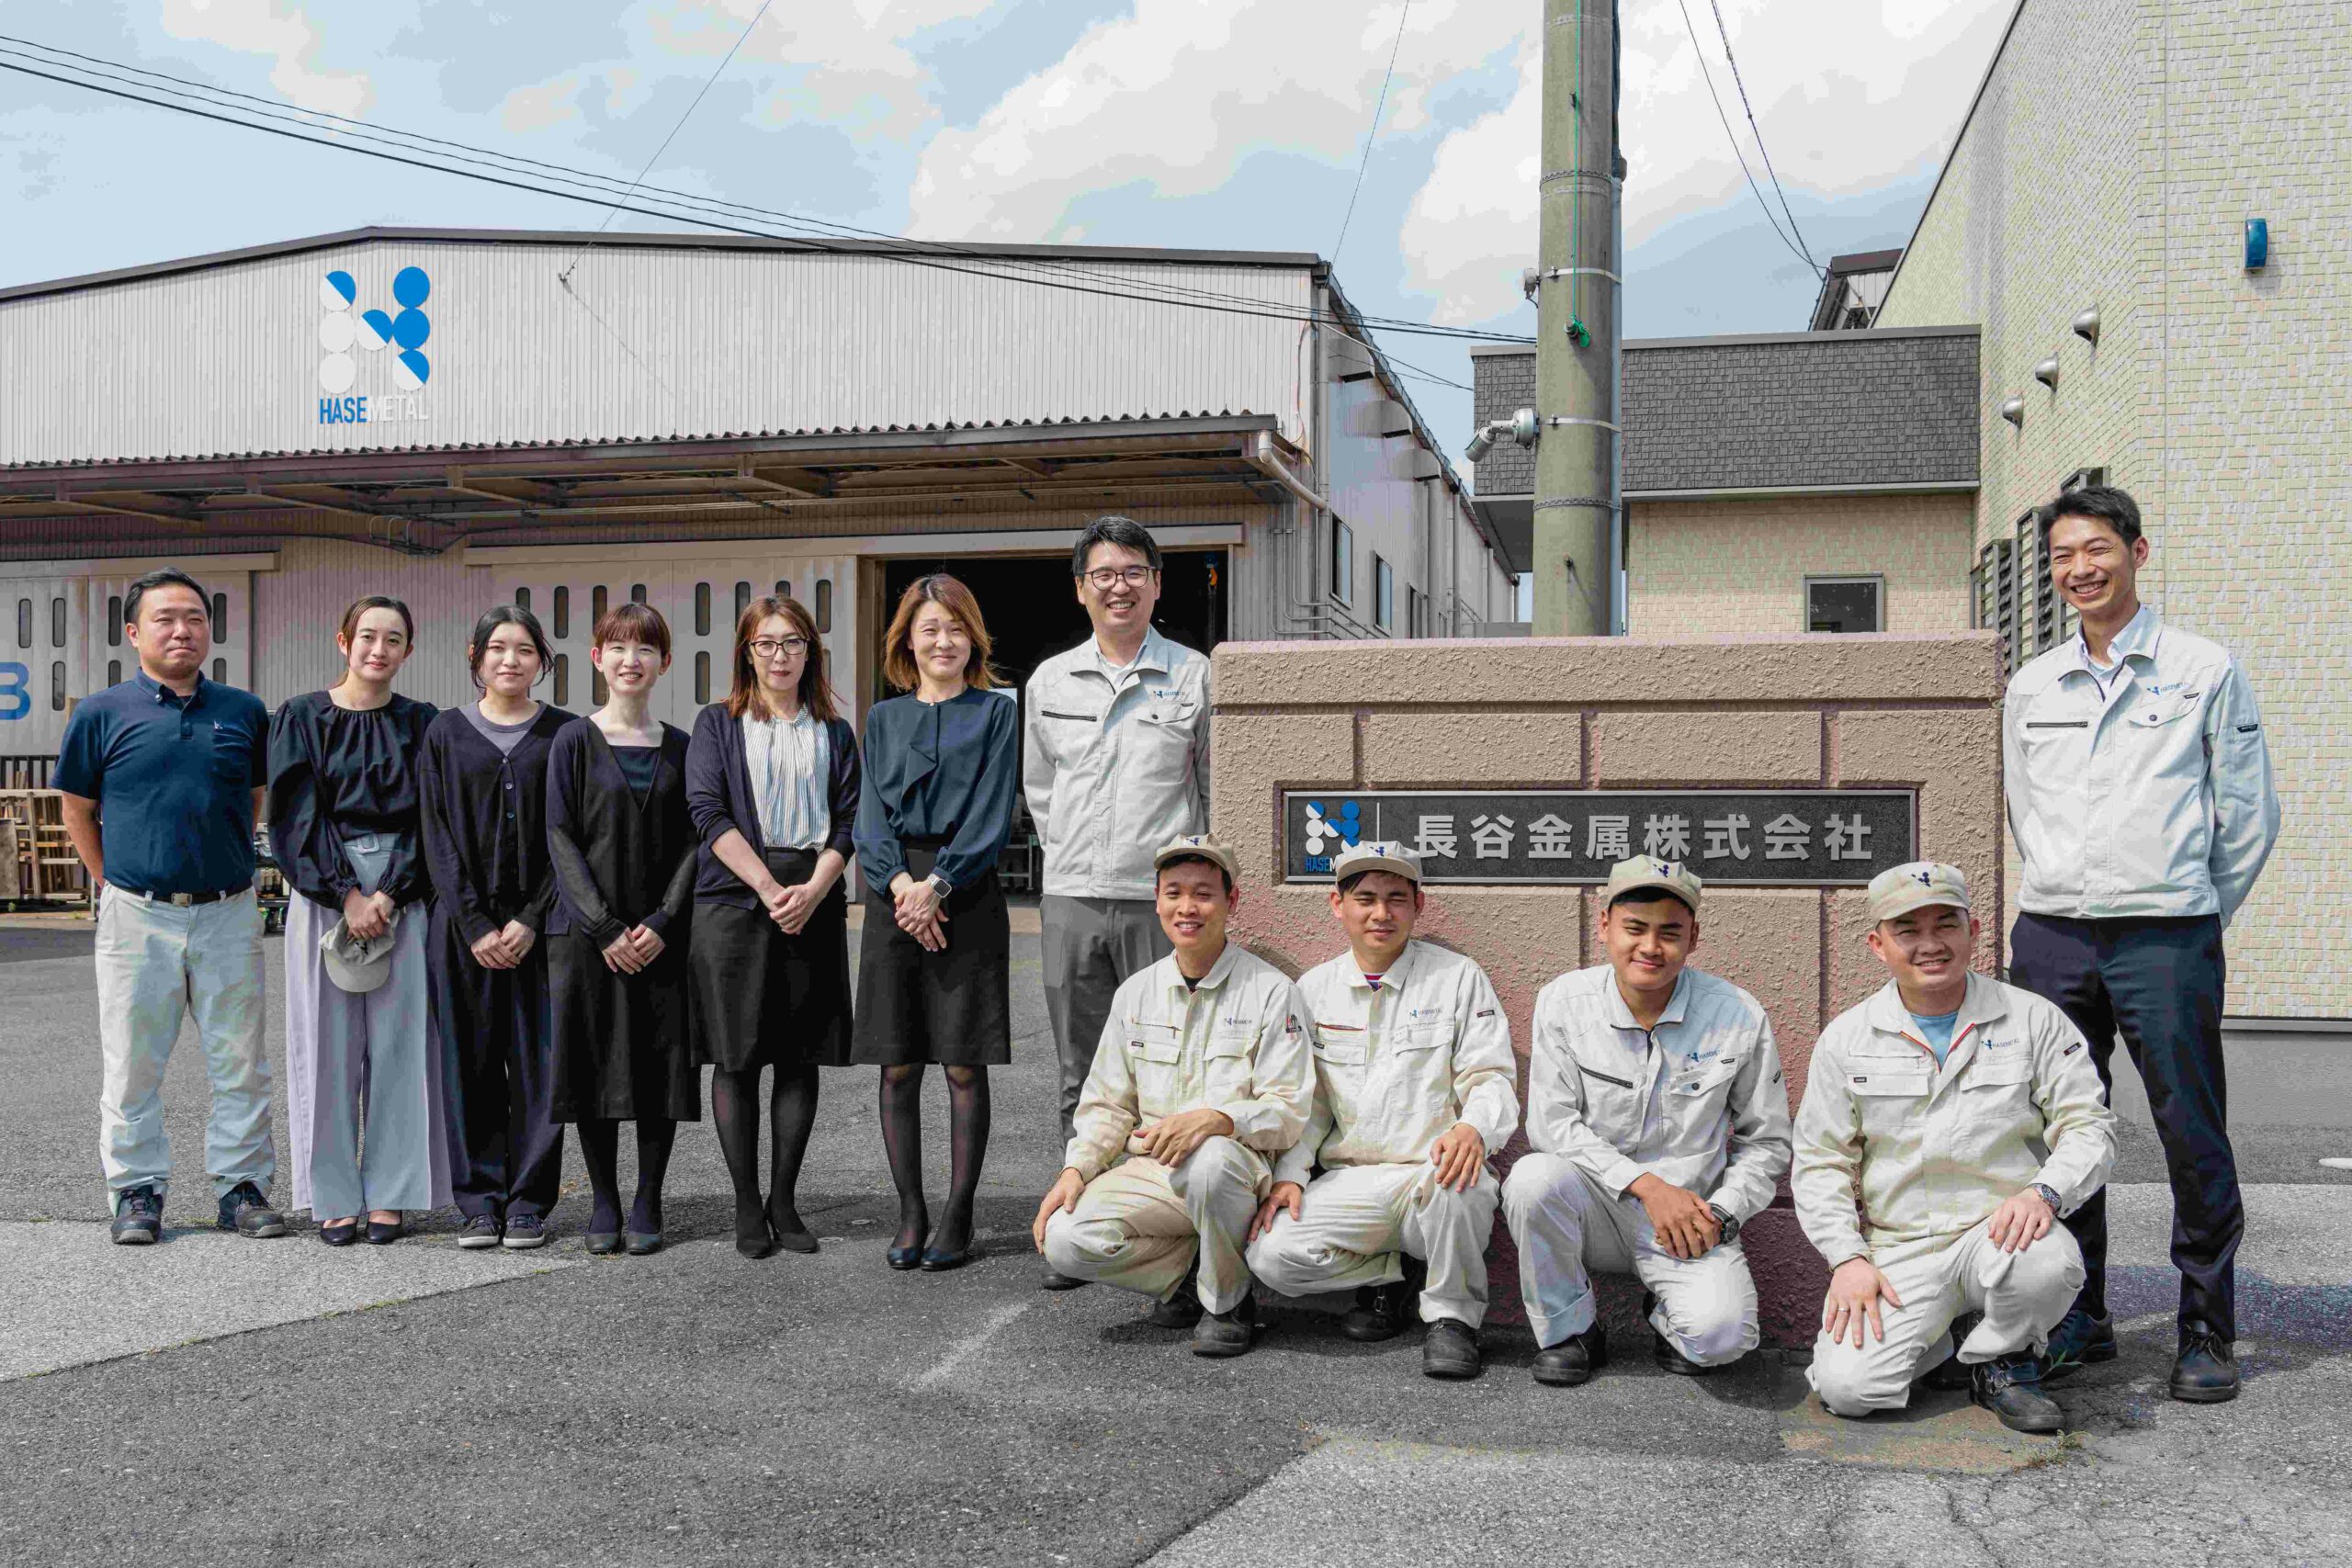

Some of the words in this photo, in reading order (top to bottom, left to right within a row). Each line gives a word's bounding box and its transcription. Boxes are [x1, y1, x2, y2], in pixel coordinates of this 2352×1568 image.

[1414, 814, 1872, 861] 長谷金属株式会社
[1306, 856, 1337, 872] HASEM
